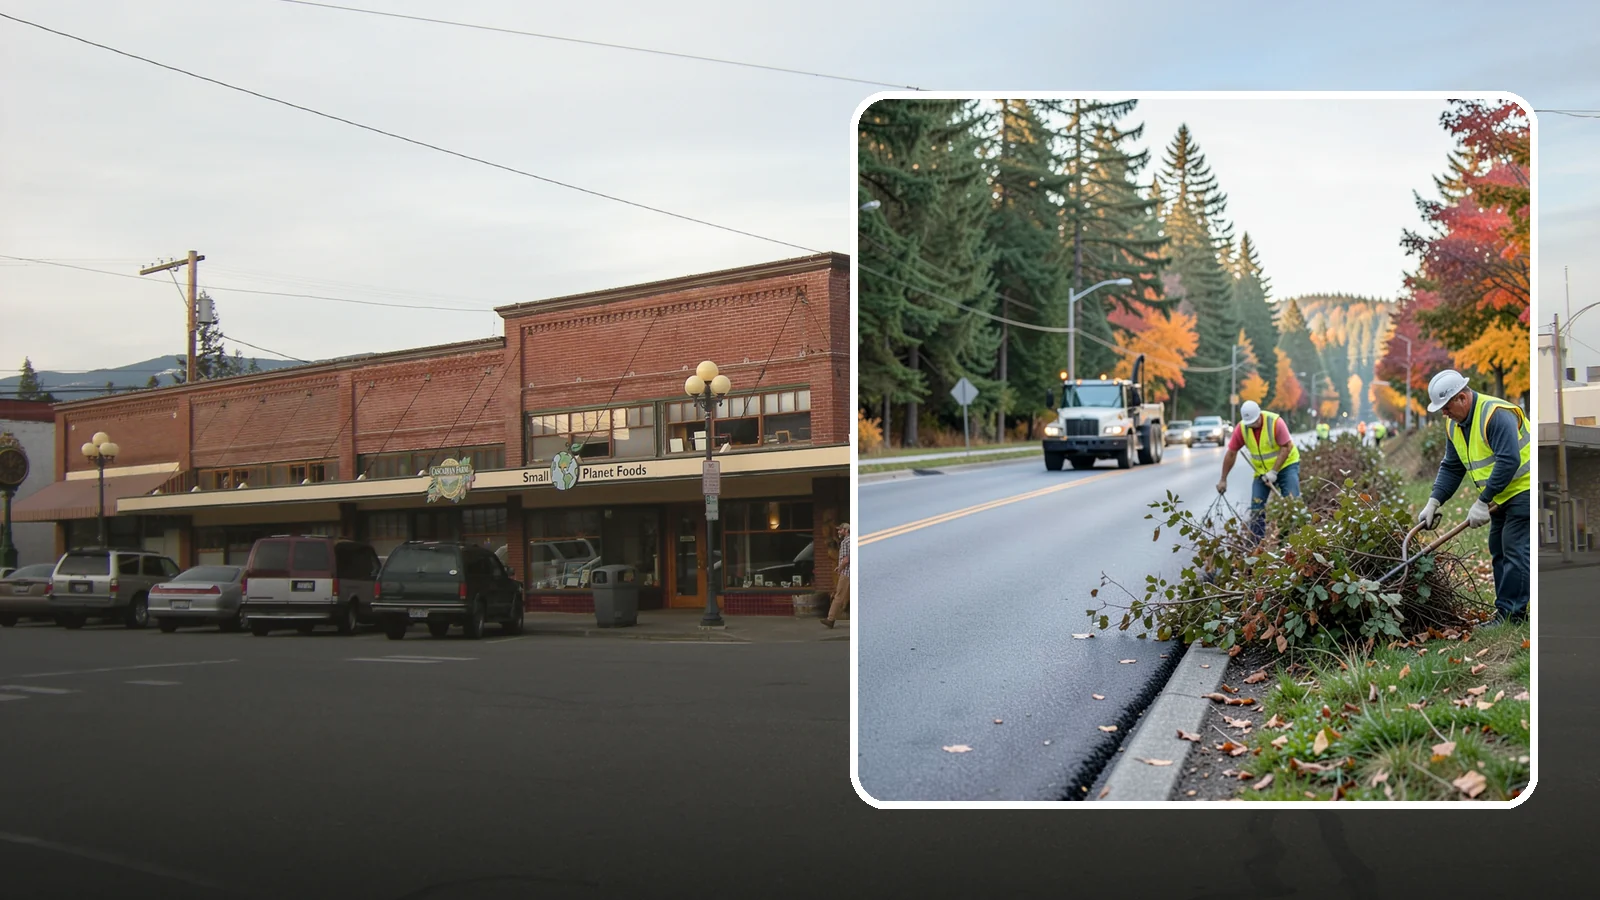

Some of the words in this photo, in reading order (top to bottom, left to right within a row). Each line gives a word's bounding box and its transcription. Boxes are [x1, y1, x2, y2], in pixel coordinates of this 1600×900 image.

[523, 470, 549, 483] Small
[583, 468, 614, 479] Planet
[616, 465, 647, 477] Foods
